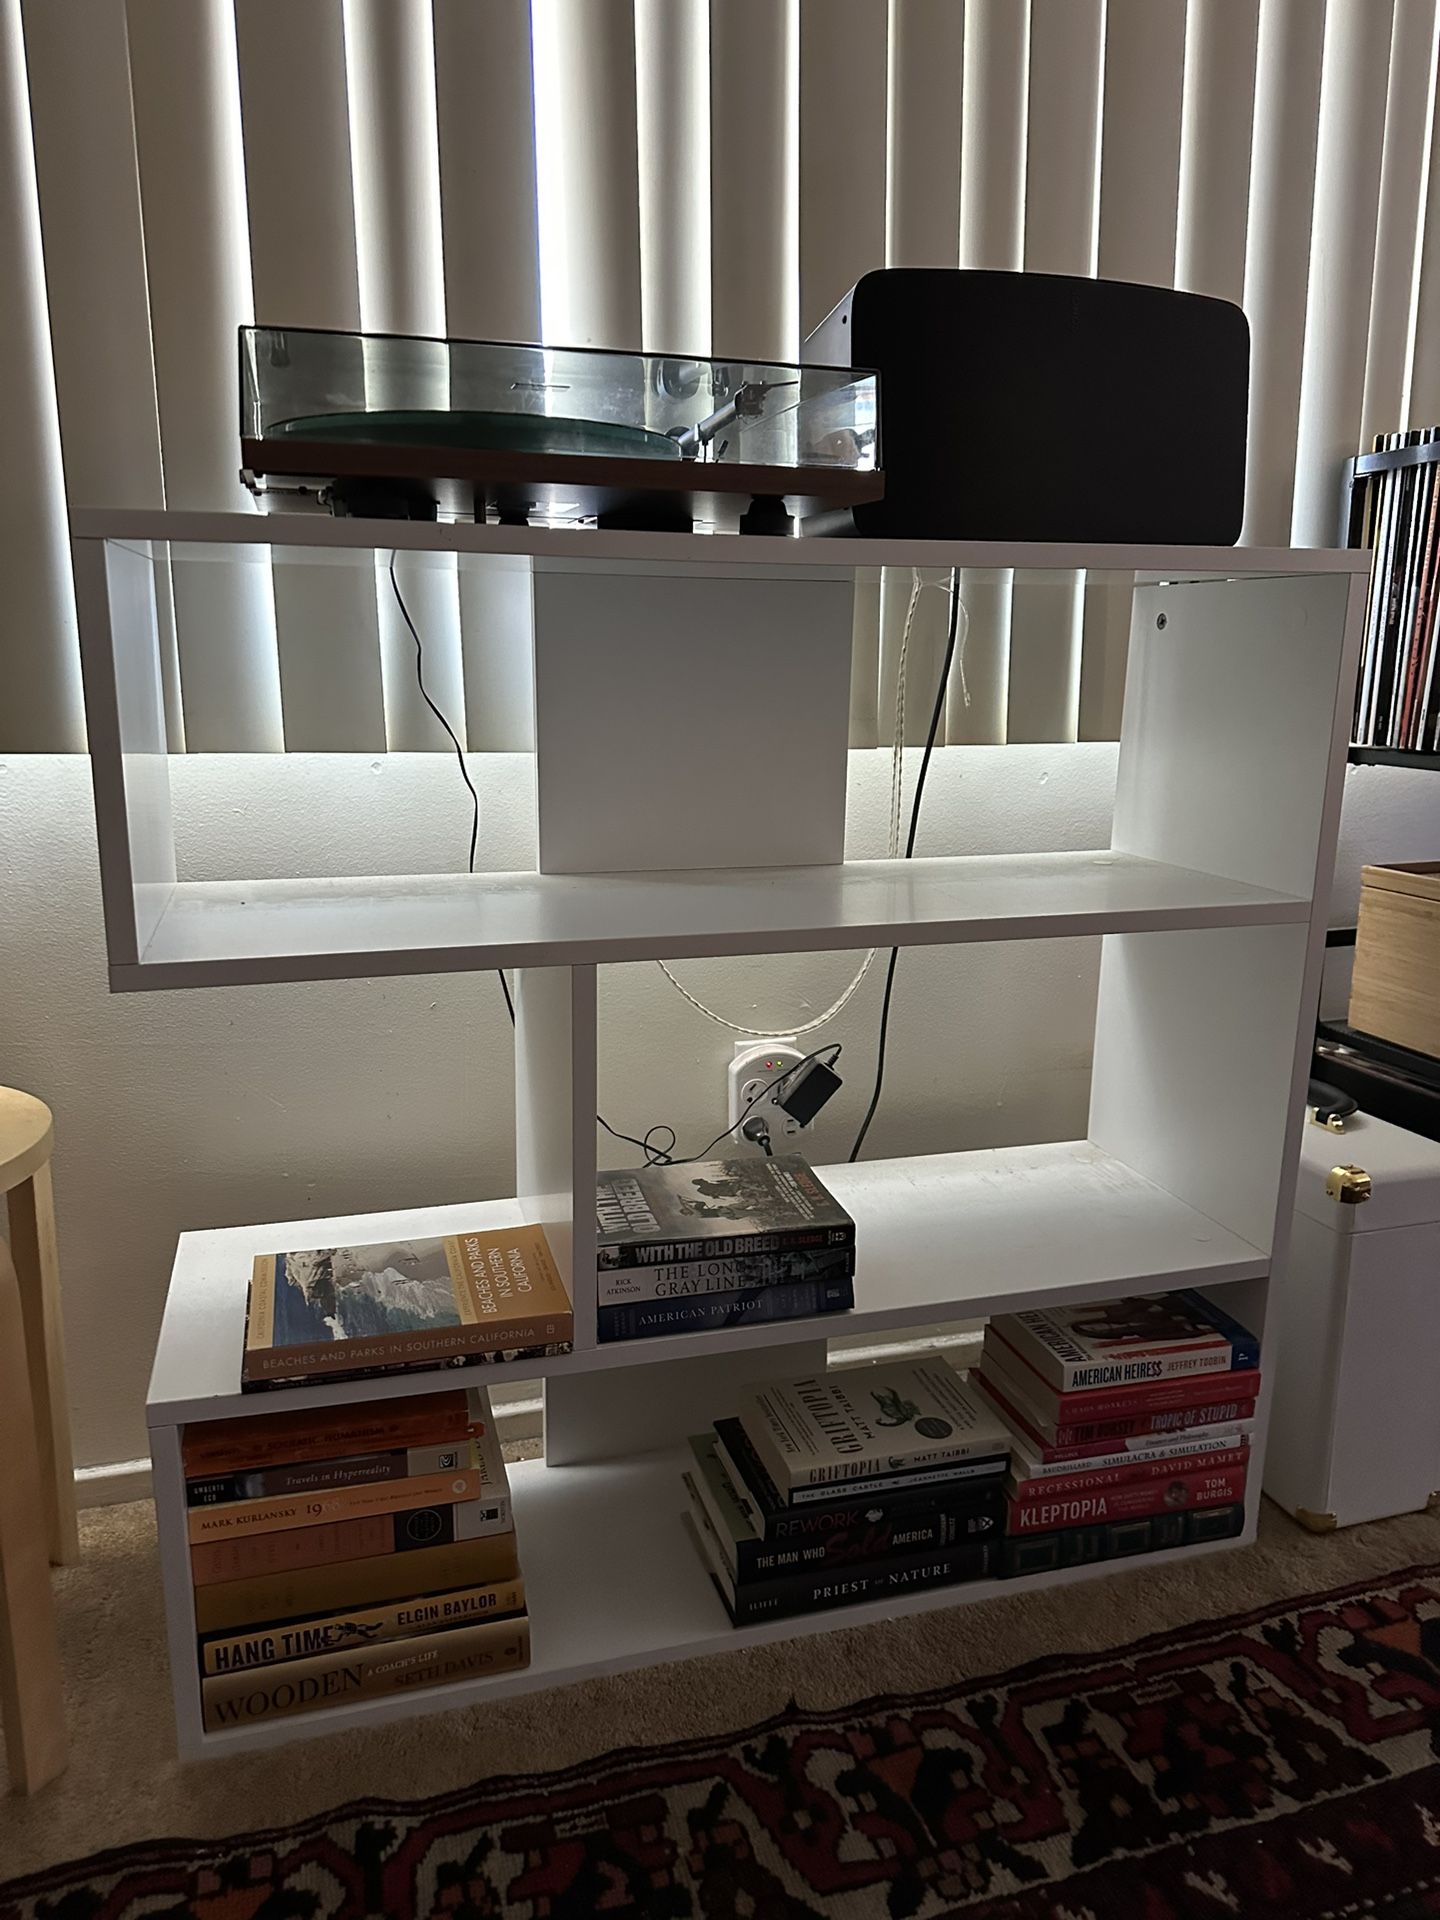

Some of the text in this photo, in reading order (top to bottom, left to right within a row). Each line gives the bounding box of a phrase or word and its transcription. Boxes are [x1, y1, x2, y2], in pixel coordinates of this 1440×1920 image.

[628, 1211, 662, 1233] OLD
[635, 1233, 780, 1264] WITH THE OLD BREED
[464, 1237, 498, 1314] BEACHES AND PARKS
[487, 1247, 514, 1300] IN SOUTHERN
[510, 1247, 533, 1294] CALIFORNIA
[615, 1278, 632, 1287] RICK
[654, 1260, 746, 1282] THE LONG
[606, 1285, 641, 1297] ATKINSON
[655, 1276, 747, 1298] GRAY LINE
[638, 1308, 706, 1326] AMERICAN
[711, 1300, 763, 1317] PATRIOT
[262, 1327, 536, 1370] BEACHES AND PARKS IN SOUTHERN CALIFORNIA
[1029, 1324, 1088, 1362] AMERICAN
[1072, 1366, 1123, 1388] AMERICAN
[1167, 1354, 1228, 1372] JEFFREY TOOBIN
[793, 1378, 865, 1455] GRIFTOPIA
[828, 1383, 876, 1440] MATT TAIBBI
[1150, 1402, 1239, 1431] TROPIC OF STUPID
[809, 1447, 970, 1483] GRIFTOPIA MATT TAIBBI
[1042, 1461, 1092, 1474] BAUDRILLARD
[1102, 1451, 1157, 1467] SIMULACRA
[1157, 1449, 1166, 1460] &
[1168, 1440, 1228, 1457] SIMULATION
[286, 1463, 392, 1486] Travels in Hyperreality
[1028, 1451, 1244, 1497] RECESSIONAL DAVID MAMET
[1205, 1477, 1226, 1489] TOM
[193, 1484, 226, 1496] UMBERTO
[203, 1494, 218, 1503] ECO
[801, 1492, 815, 1500] THE
[820, 1487, 847, 1497] GLASS
[852, 1481, 883, 1492] CASTLE
[1196, 1486, 1233, 1501] BURGIS
[200, 1507, 298, 1531] MARK KURLANSKY
[775, 1510, 859, 1538] REWORK
[1020, 1496, 1108, 1528] KLEPTOPIA
[757, 1555, 774, 1569] THE
[777, 1551, 799, 1565] MAN
[802, 1546, 825, 1560] WHO
[892, 1528, 933, 1546] AMERICA
[813, 1578, 870, 1600] PRIEST
[889, 1563, 952, 1585] NATURE
[397, 1606, 440, 1626] ELGIN
[443, 1592, 497, 1616] BAYLOR
[215, 1624, 334, 1671] HANG TIME
[367, 1650, 440, 1677] A COACH'S LIFE
[394, 1650, 496, 1688] SETH DAVIS
[214, 1662, 365, 1725] WOODEN
